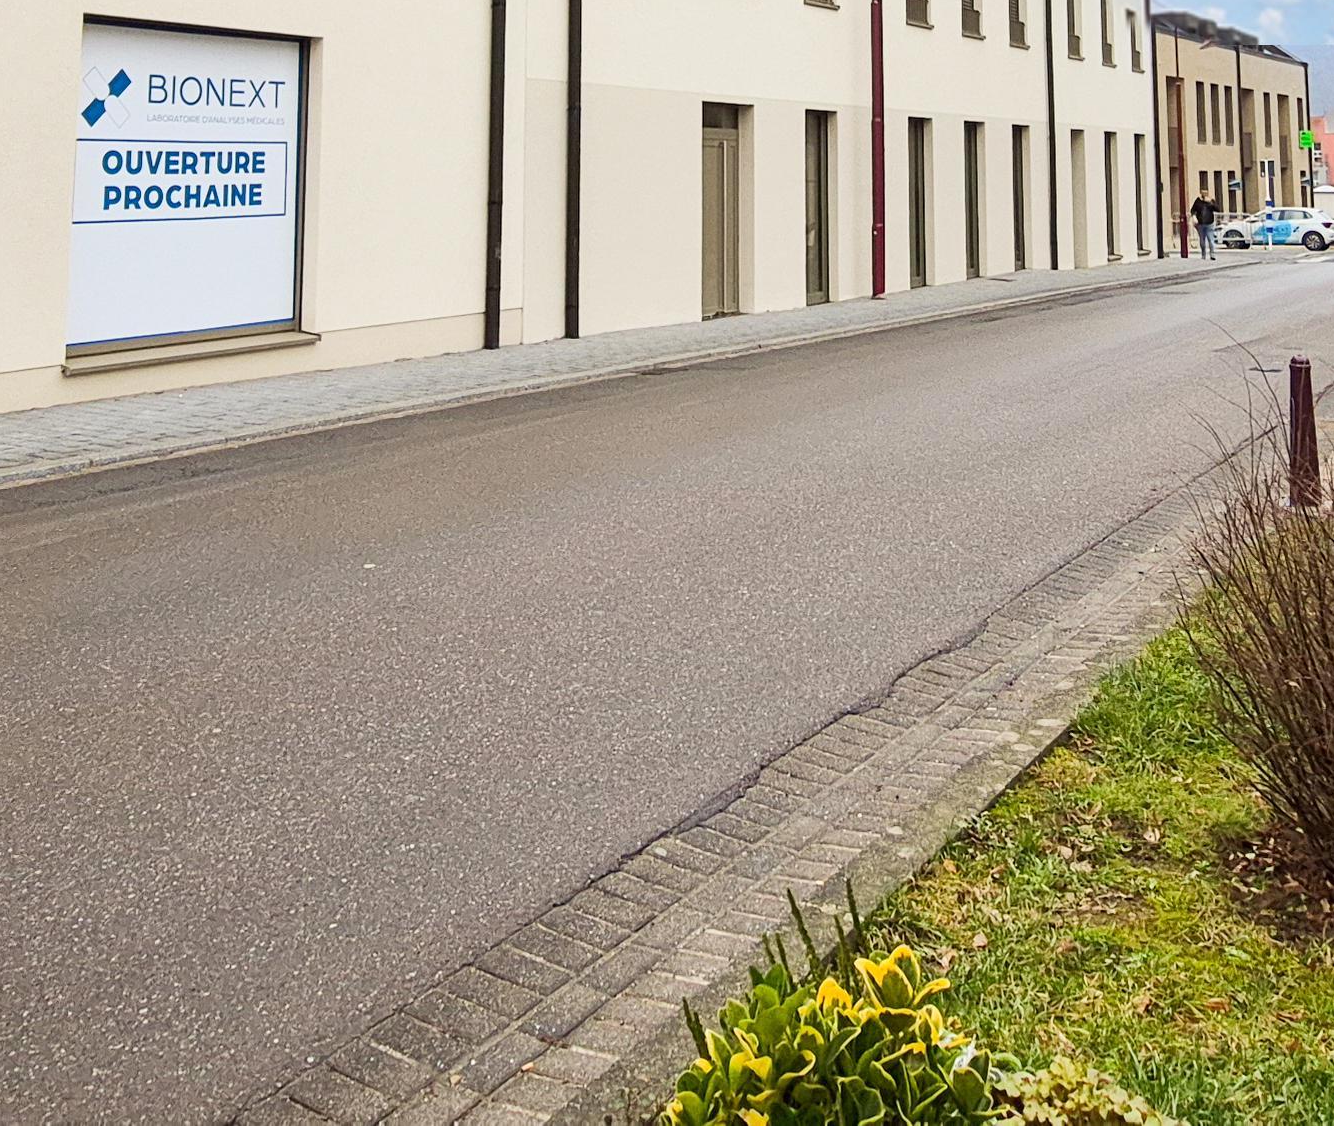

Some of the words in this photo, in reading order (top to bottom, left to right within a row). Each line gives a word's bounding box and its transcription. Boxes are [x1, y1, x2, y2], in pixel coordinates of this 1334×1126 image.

[147, 74, 286, 109] BIONEXT
[102, 150, 266, 175] OUVERTURE
[103, 184, 263, 210] PROCHAINE
